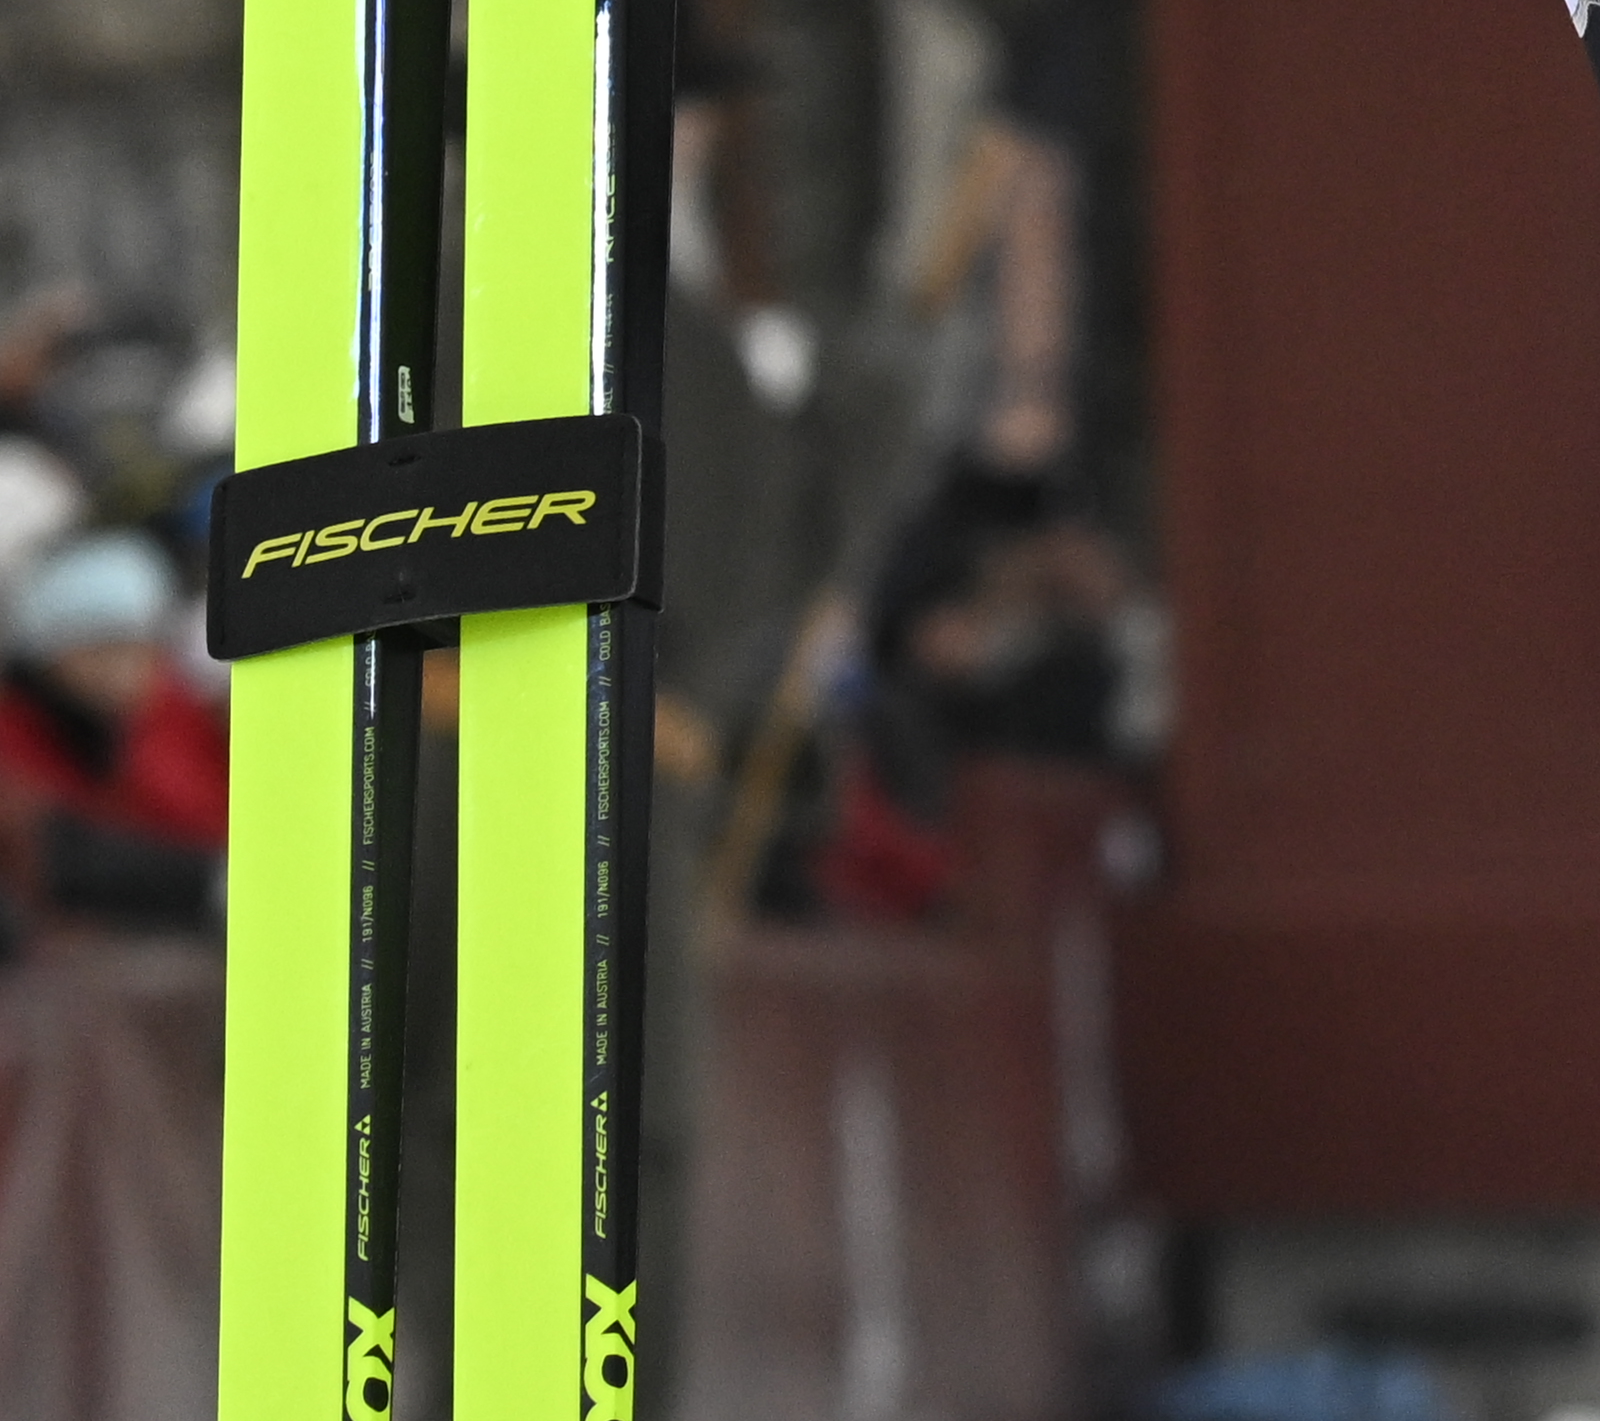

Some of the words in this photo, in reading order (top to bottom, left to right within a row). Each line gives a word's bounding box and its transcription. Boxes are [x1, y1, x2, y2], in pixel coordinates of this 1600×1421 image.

[241, 490, 596, 579] FISCHER
[600, 630, 611, 661] COLD
[363, 726, 375, 845] FISCHERSPORTS.COM
[598, 701, 609, 820] FISCHERSPORTS.COM
[361, 983, 372, 1034] AUSTRIA
[597, 959, 608, 1009] AUSTRIA
[361, 1037, 372, 1050] IN
[596, 1014, 608, 1026] IN
[360, 1054, 371, 1089] MADE
[596, 1030, 607, 1065] MADE
[358, 1137, 371, 1261] FISCHER
[595, 1114, 607, 1238] FISCHER
